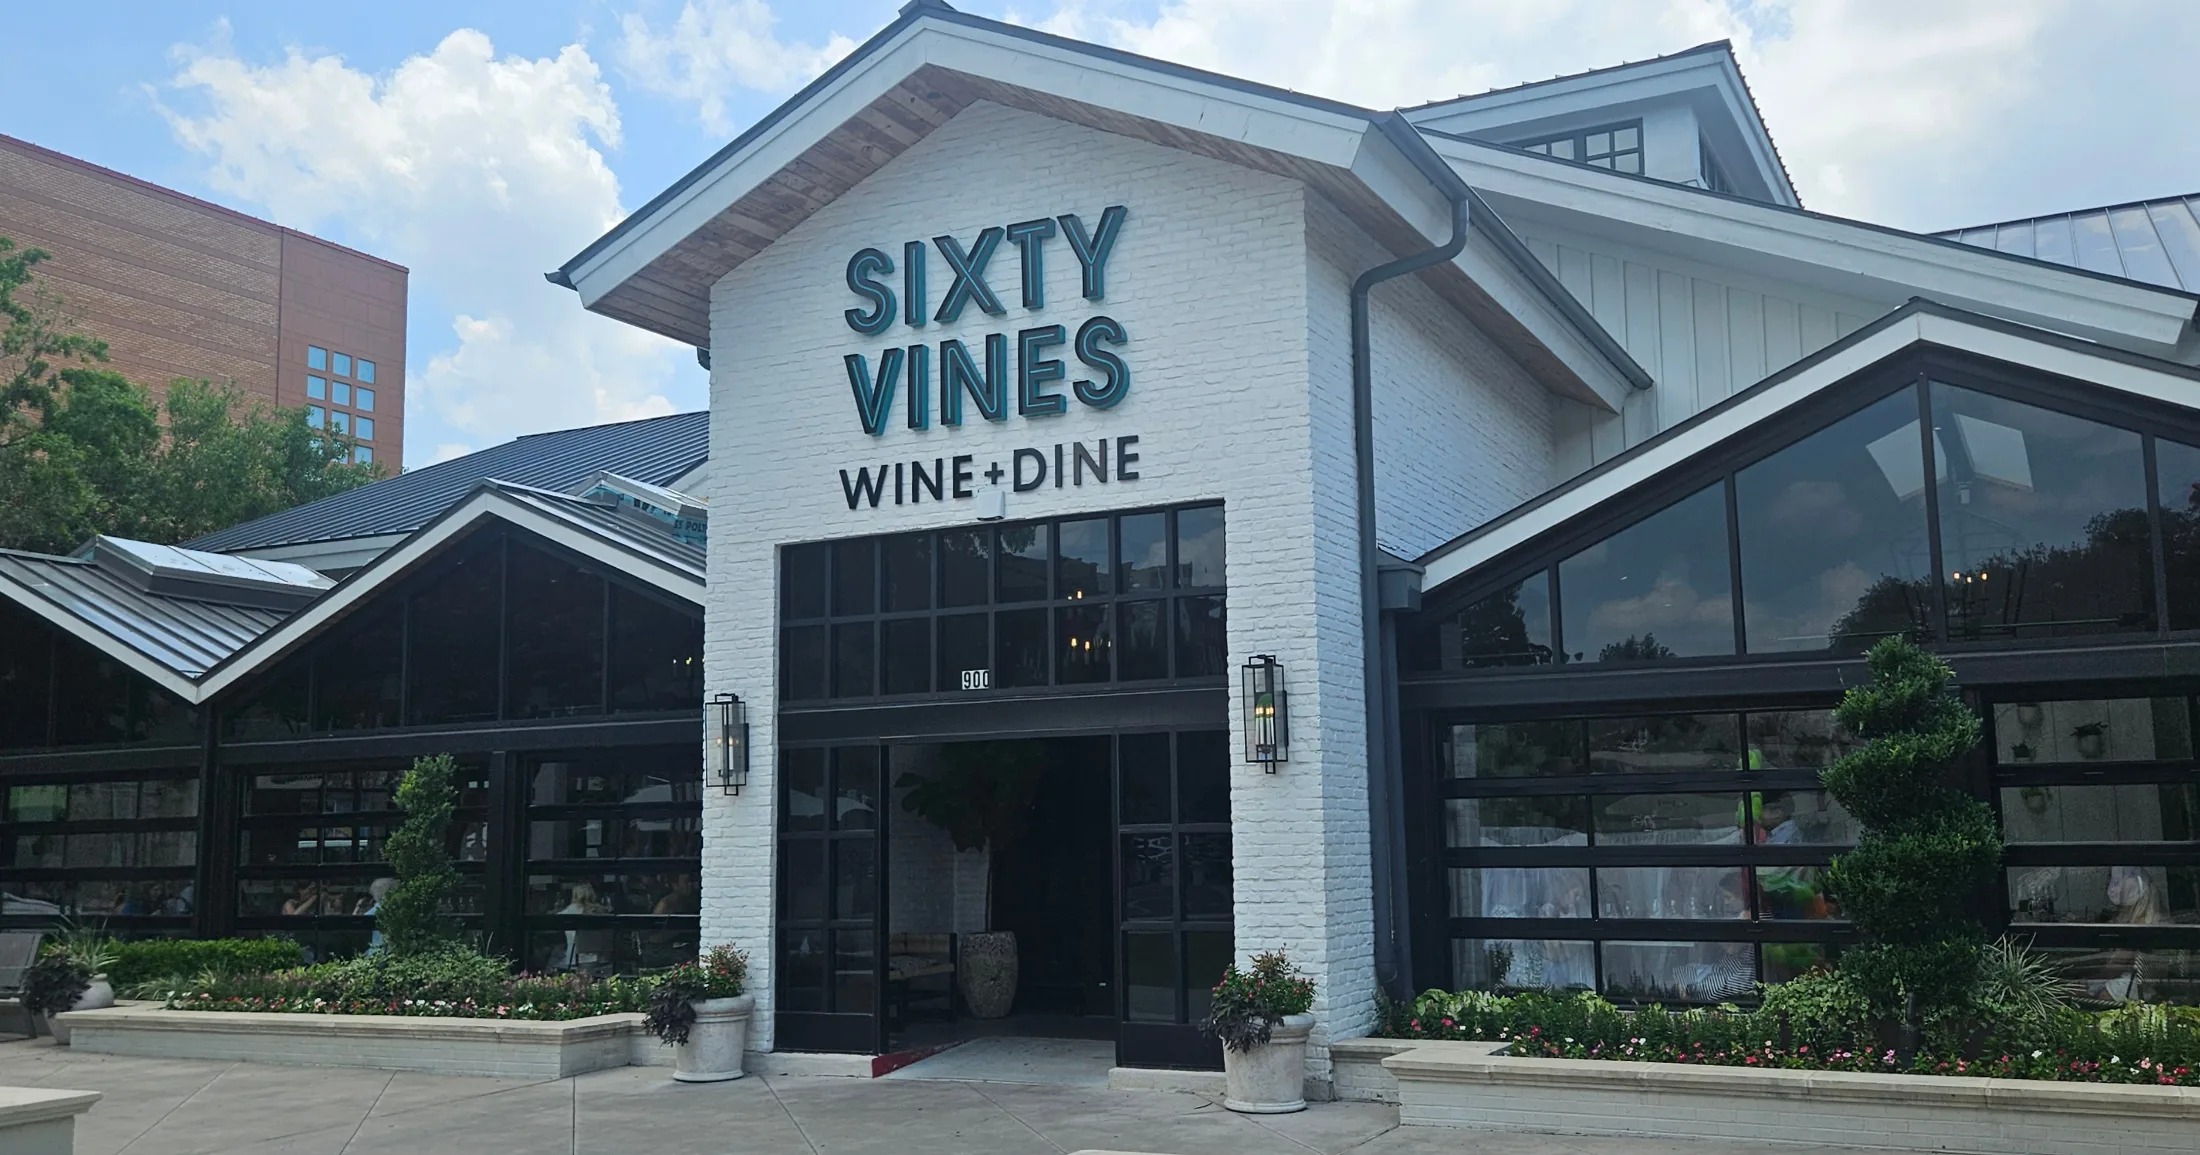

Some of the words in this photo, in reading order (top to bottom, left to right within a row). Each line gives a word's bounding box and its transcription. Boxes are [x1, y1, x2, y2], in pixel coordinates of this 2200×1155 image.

[844, 205, 1128, 337] SIXTY
[843, 315, 1130, 437] VINES
[963, 671, 990, 689] 900
